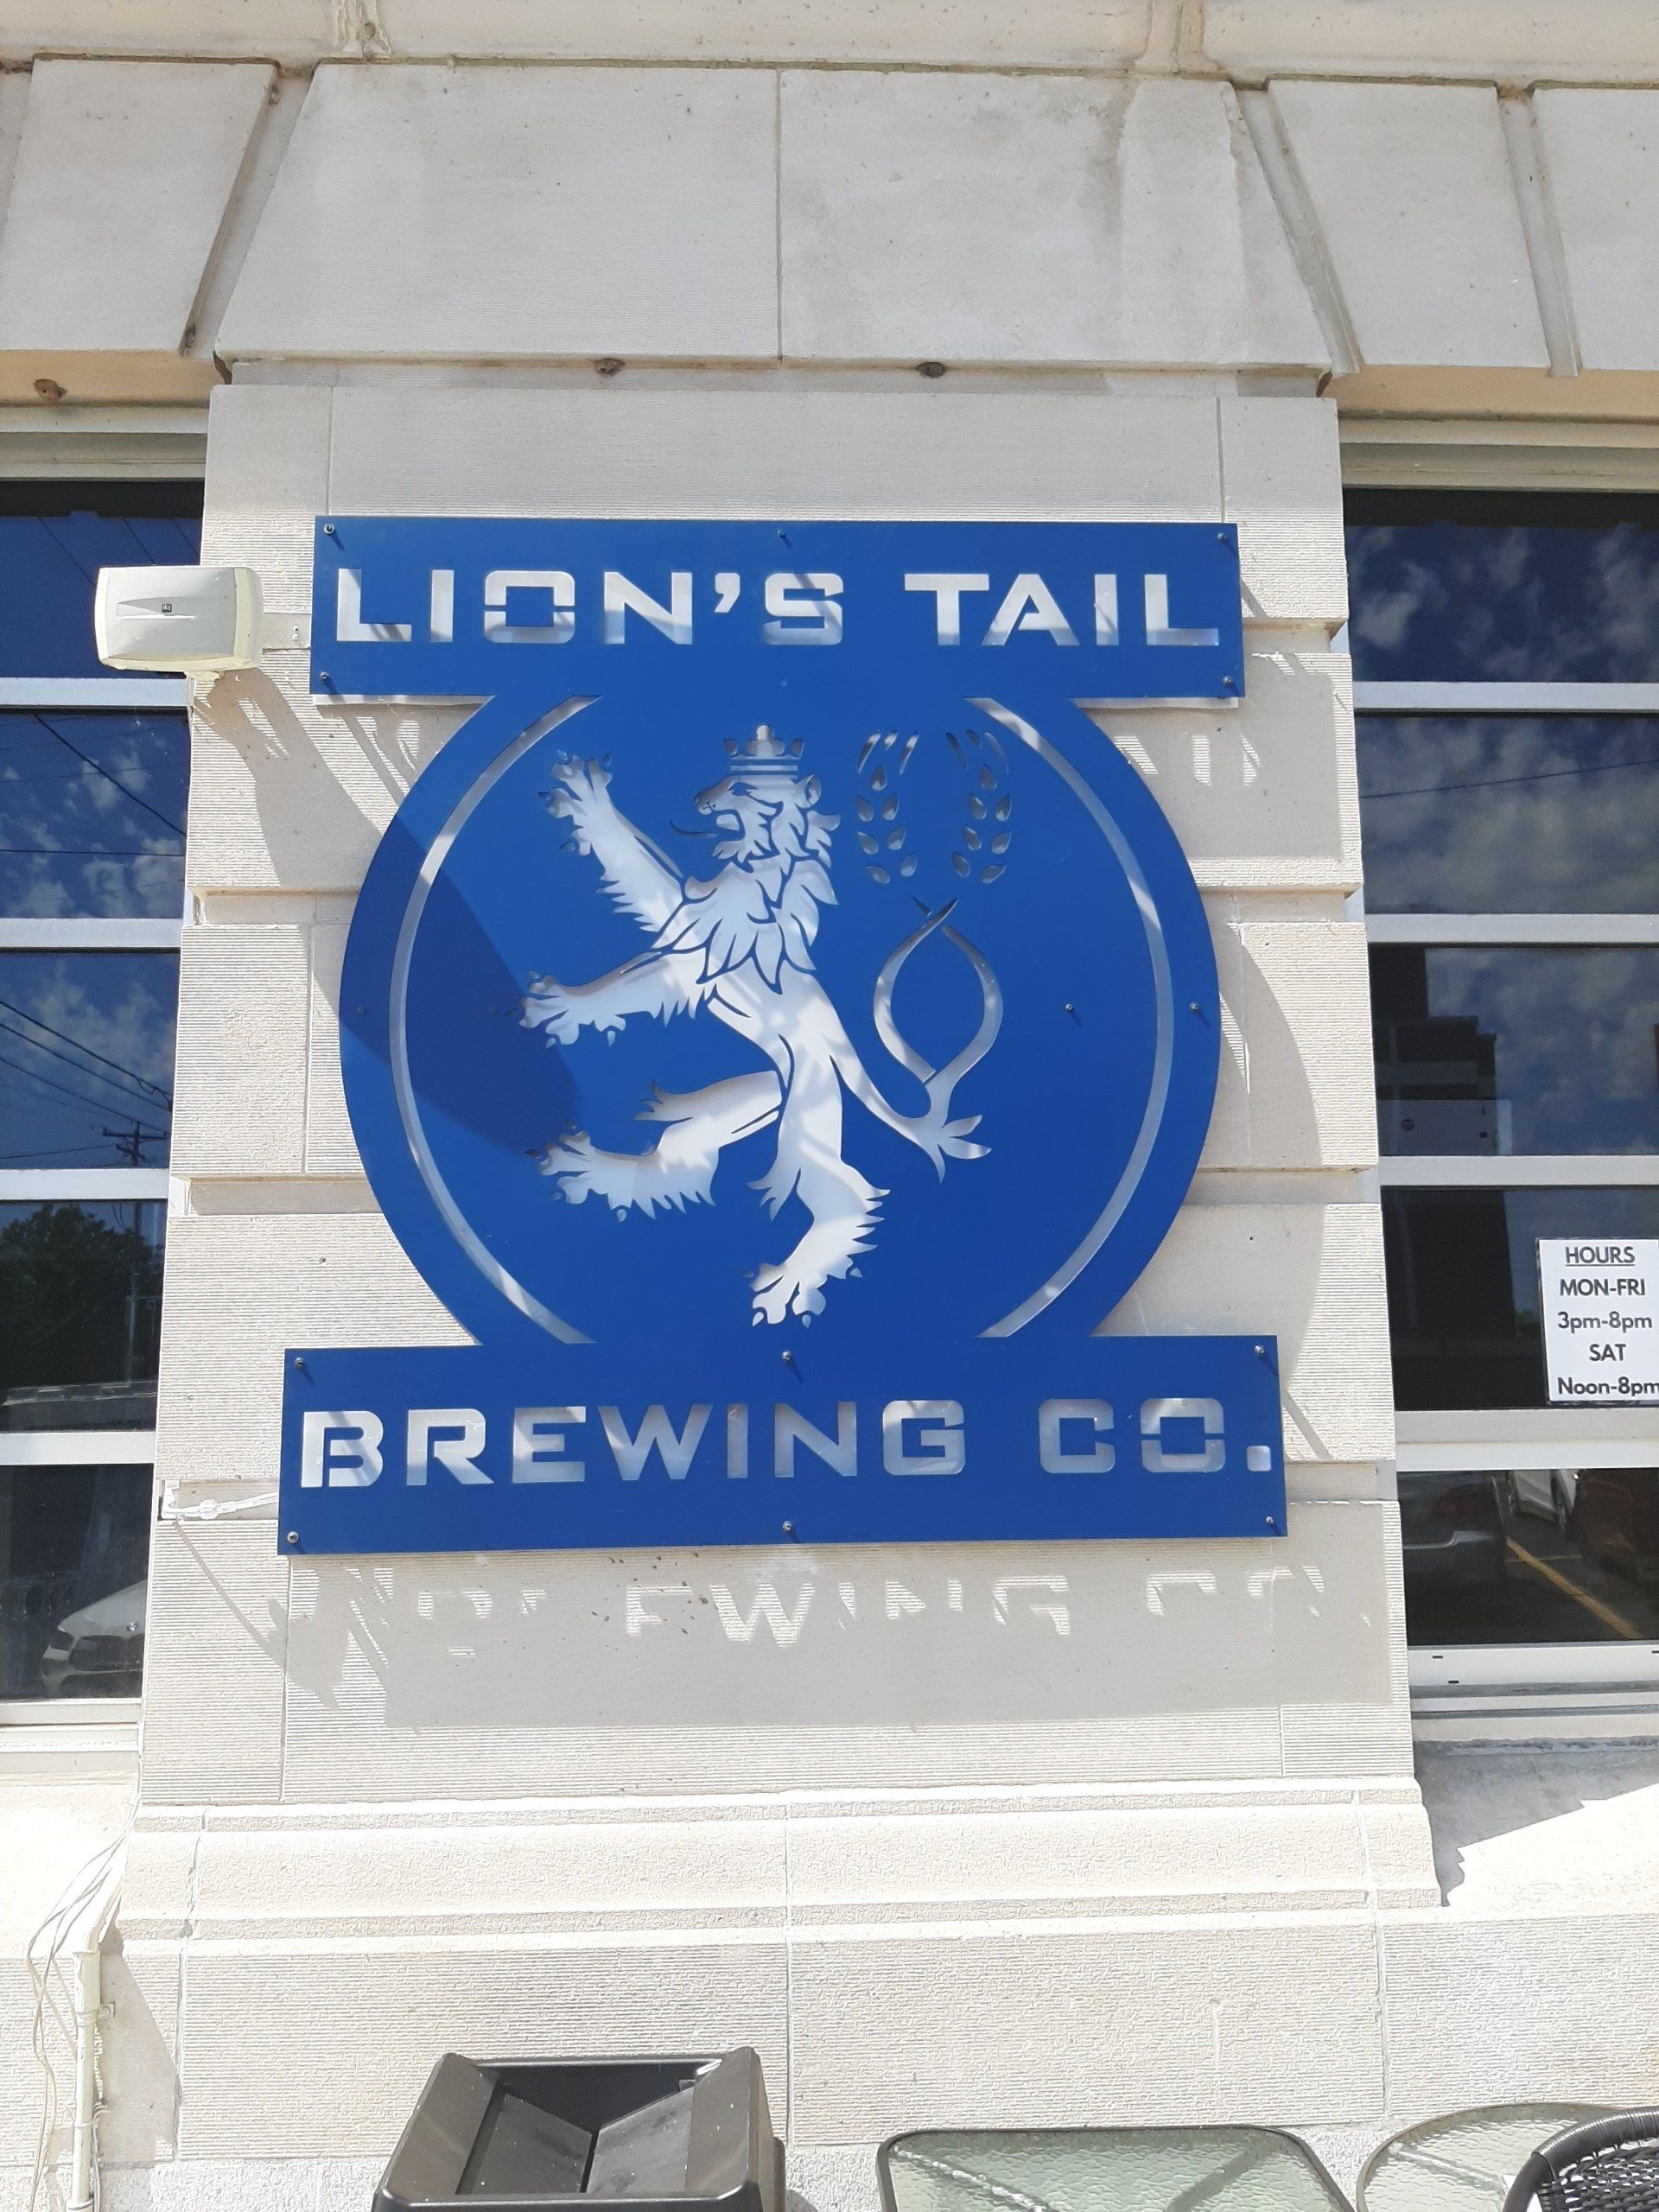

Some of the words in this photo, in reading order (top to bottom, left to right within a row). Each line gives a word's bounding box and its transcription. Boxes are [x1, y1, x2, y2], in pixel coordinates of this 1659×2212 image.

[335, 567, 844, 646] LION'S
[903, 571, 1221, 648] TAIL
[1565, 1246, 1636, 1264] HOURS
[1559, 1278, 1646, 1297] MON-FRI
[1557, 1310, 1654, 1334] 3pm-8pm
[1588, 1344, 1627, 1362] SAT
[1557, 1376, 1659, 1397] Noon-8pm
[300, 1398, 967, 1489] BREWING
[1038, 1396, 1273, 1476] CO.
